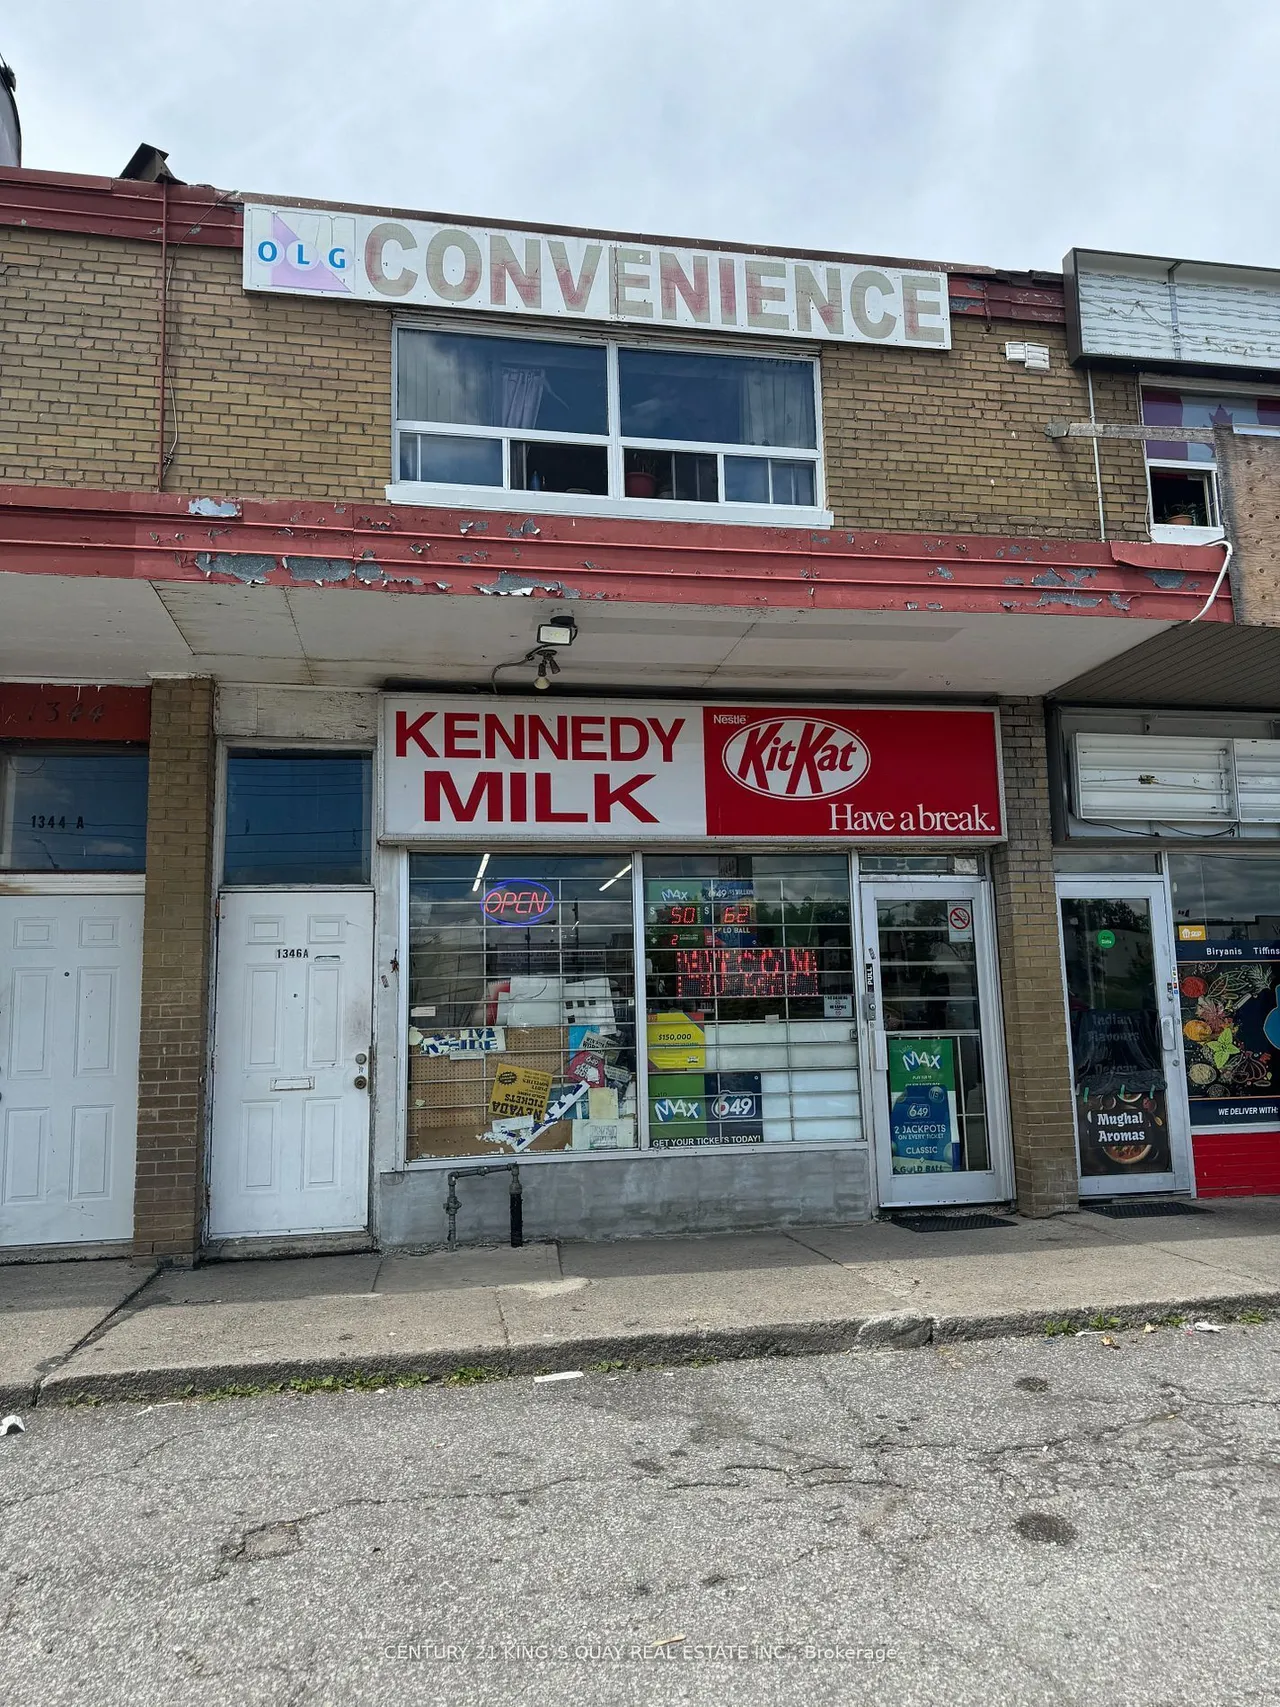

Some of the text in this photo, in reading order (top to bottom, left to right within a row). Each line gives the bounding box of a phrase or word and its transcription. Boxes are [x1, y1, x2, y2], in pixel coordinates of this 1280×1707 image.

[363, 222, 947, 343] CONVENIENCE
[394, 710, 686, 763] KENNEDY
[423, 770, 661, 824] MILK
[31, 815, 85, 829] 1344 A
[829, 803, 997, 833] Have a break.
[662, 888, 688, 901] MAX
[485, 892, 547, 913] OPEN
[671, 906, 696, 924] 50
[723, 905, 749, 924] 62
[276, 948, 309, 959] 1346A
[1206, 946, 1280, 957] Biryanis Tiffins
[1091, 1013, 1133, 1025] Indian
[658, 1033, 692, 1041] $150,000
[902, 1050, 941, 1072] MAX
[504, 1093, 544, 1108] TICKETS
[715, 1094, 753, 1116] 649
[654, 1098, 699, 1122] MAX
[909, 1105, 928, 1117] 649
[1218, 1105, 1279, 1116] WE DELIVER WITH:
[1097, 1111, 1143, 1128] Mughal
[895, 1124, 946, 1134] 2 JACKPOTS
[1098, 1129, 1145, 1143] Aromas
[653, 1134, 761, 1147] GET YOUR TICKETS TODAY!
[905, 1146, 938, 1154] CLASSIC
